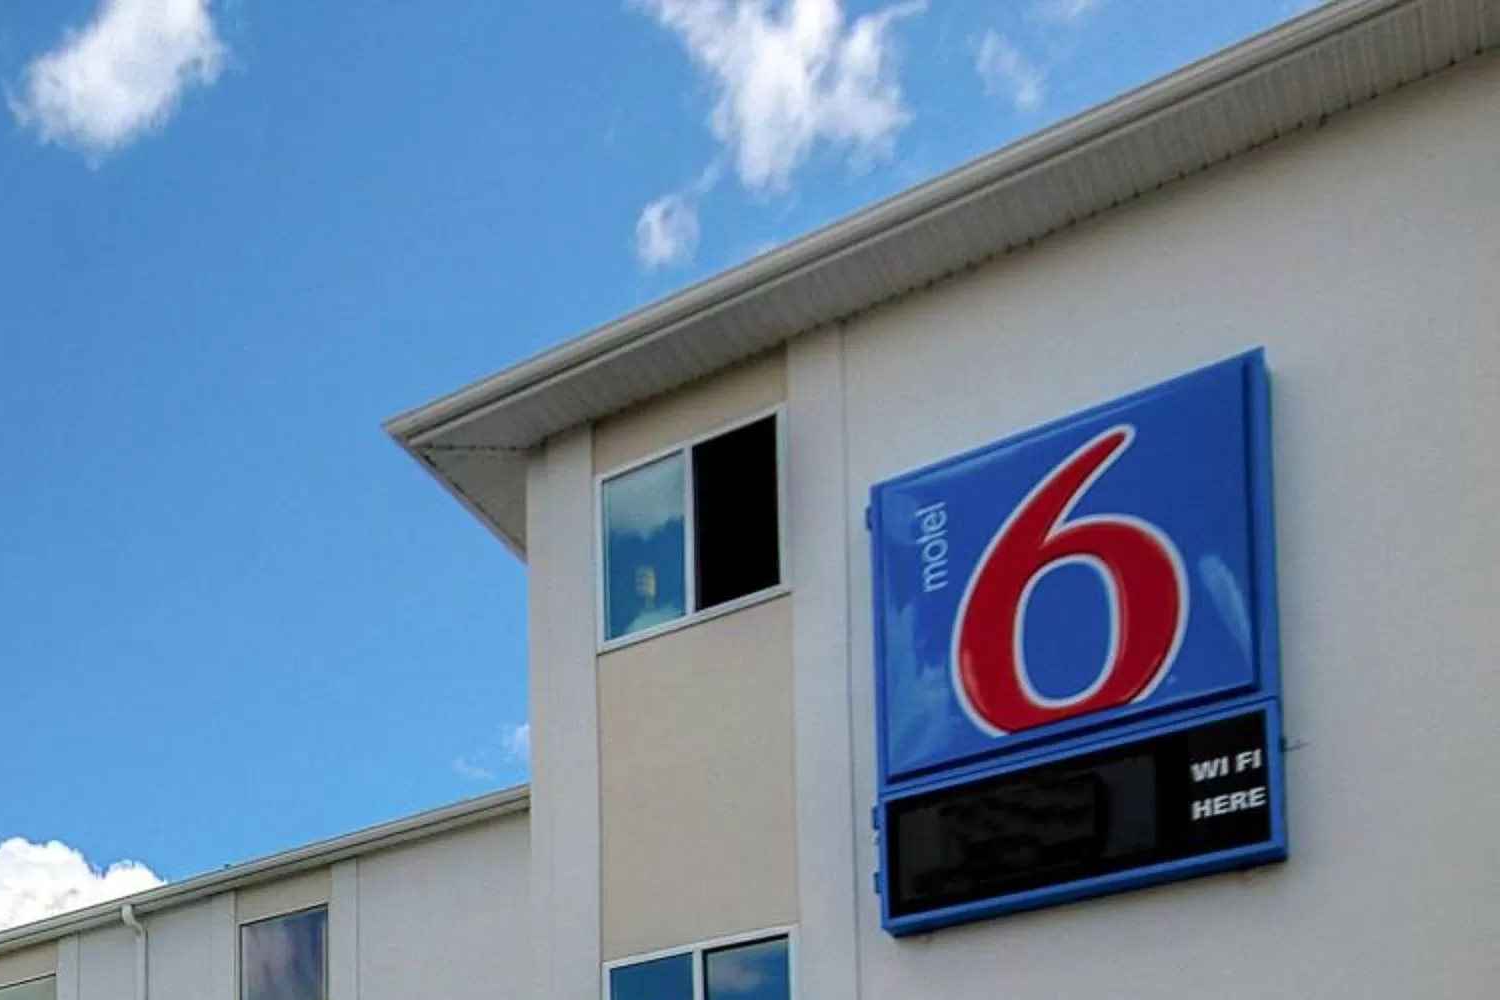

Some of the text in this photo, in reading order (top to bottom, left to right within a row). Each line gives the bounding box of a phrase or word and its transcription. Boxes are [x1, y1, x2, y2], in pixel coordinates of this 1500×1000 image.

[916, 501, 948, 592] motel
[950, 424, 1189, 736] 6
[1190, 748, 1262, 782] WI FI
[1192, 786, 1267, 821] HERE
